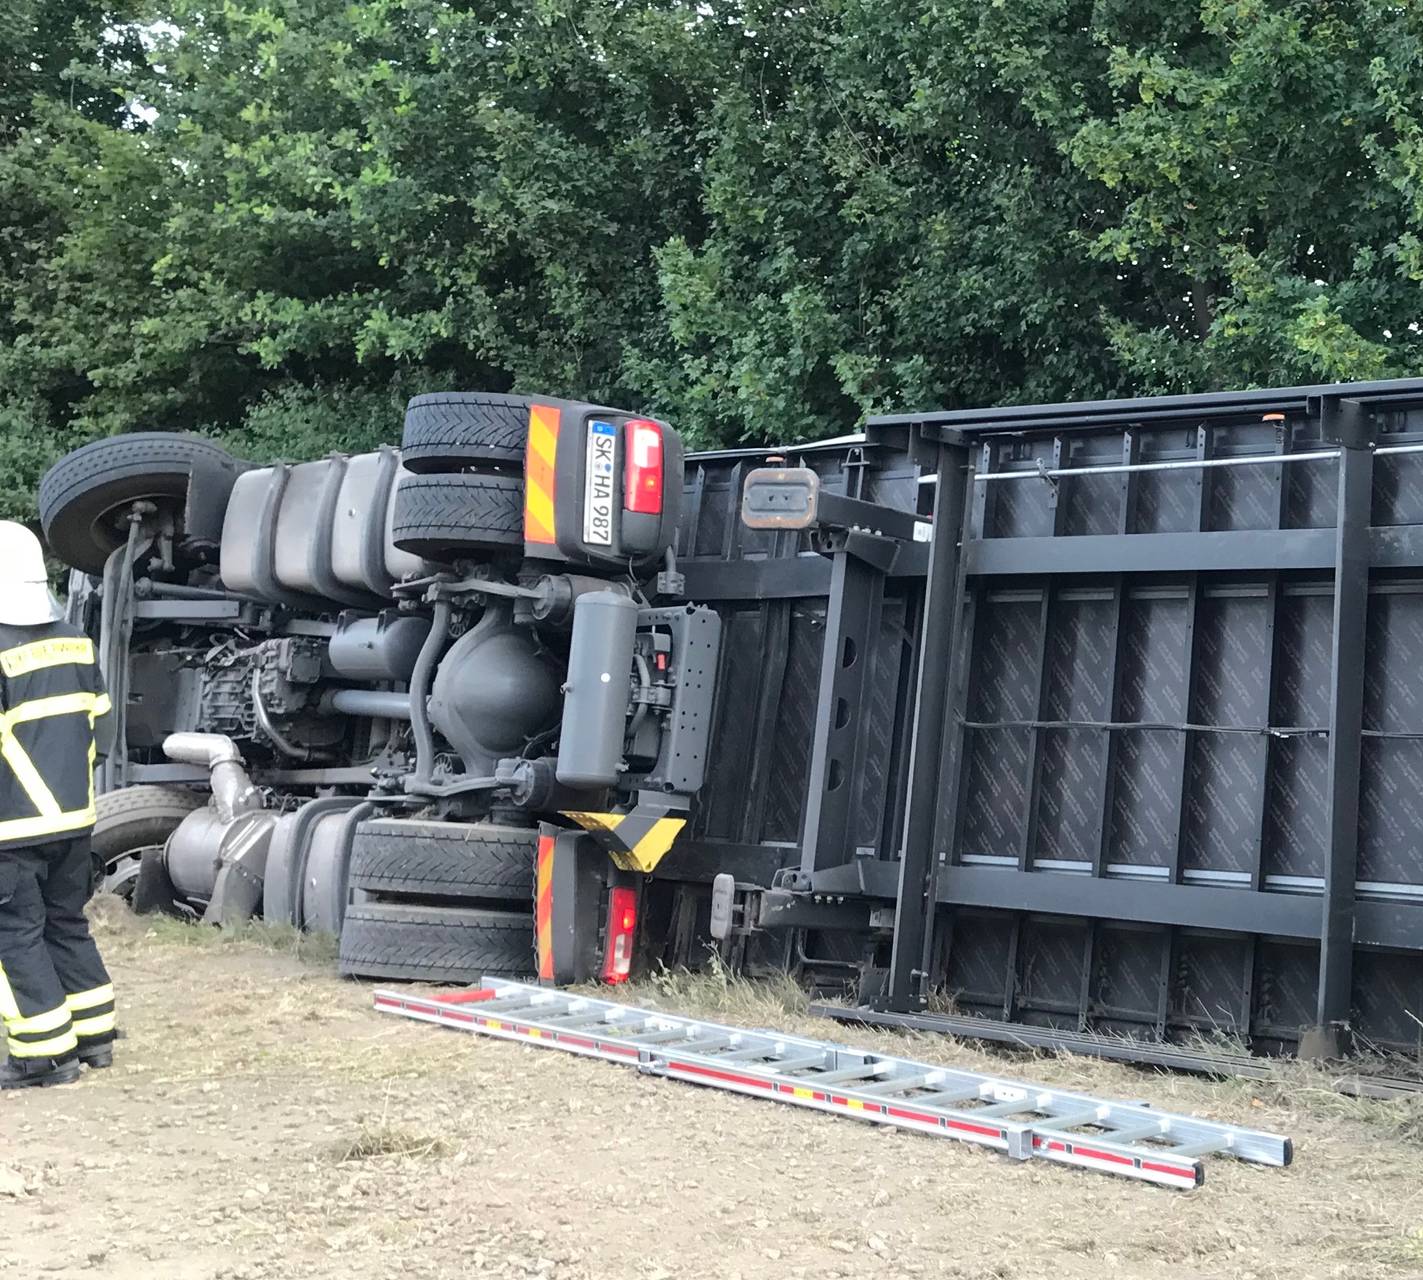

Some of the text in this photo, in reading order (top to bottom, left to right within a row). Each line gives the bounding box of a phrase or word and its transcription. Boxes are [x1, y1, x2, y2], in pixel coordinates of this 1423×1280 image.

[592, 436, 612, 541] SK HA 987
